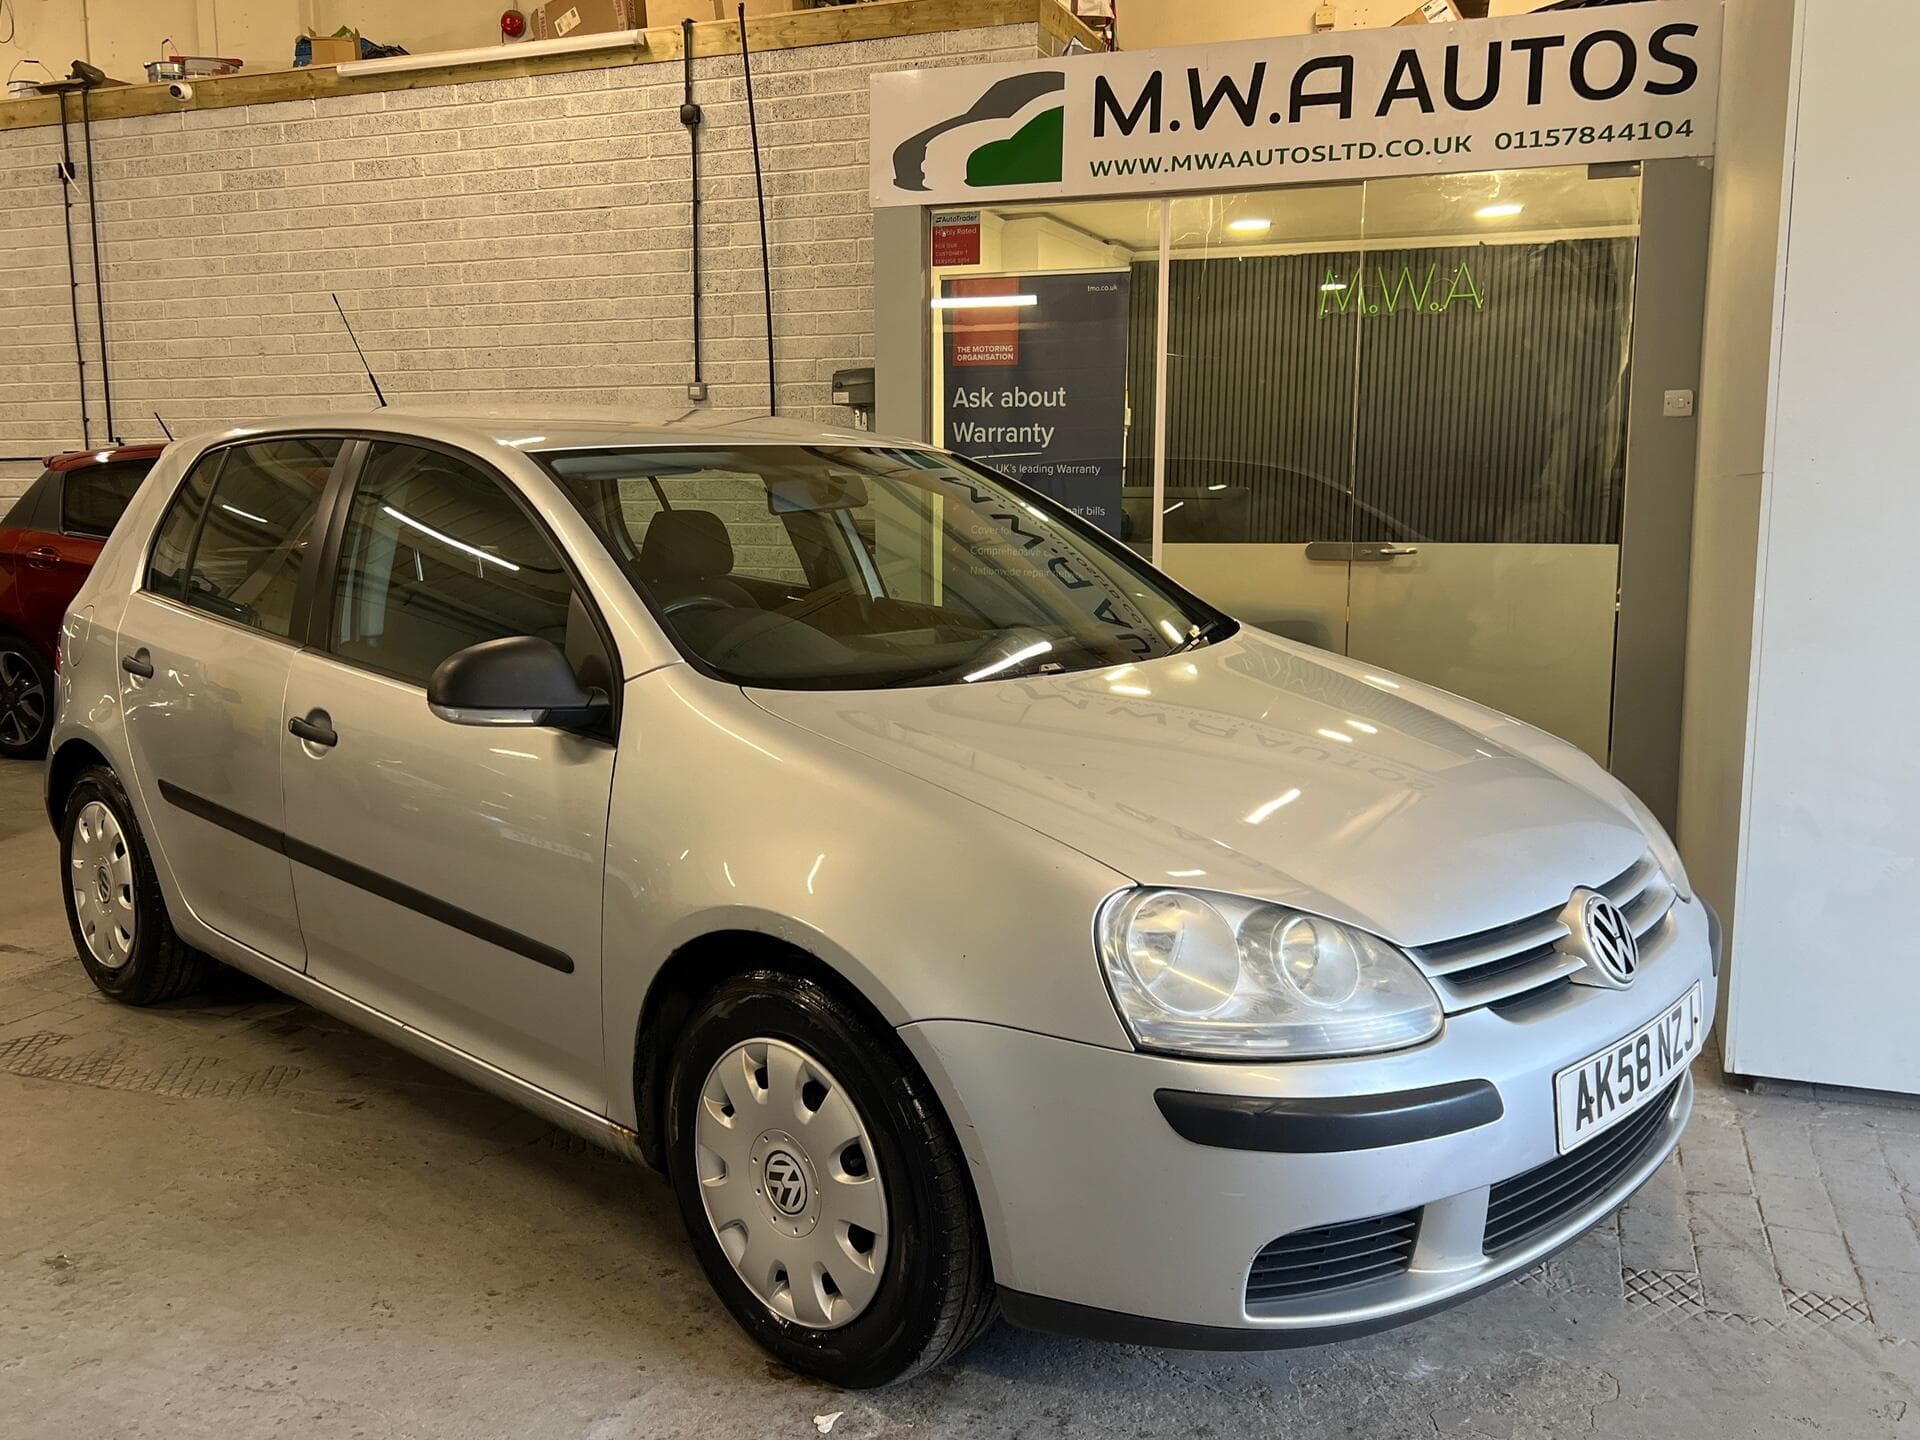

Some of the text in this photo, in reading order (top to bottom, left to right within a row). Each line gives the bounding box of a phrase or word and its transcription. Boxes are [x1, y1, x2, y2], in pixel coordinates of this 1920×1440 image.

[1093, 22, 1699, 138] M.W.A AUTOS
[1089, 118, 1694, 178] WWW.MWAAUTOSLTD.CO.UK 01157844104
[942, 214, 977, 223] AutoTrader
[1087, 283, 1118, 293] tmo.co.uk
[1320, 262, 1482, 317] M.W.A
[957, 344, 1014, 354] THE MOTORING
[957, 352, 1014, 362] ORGANISATION
[952, 385, 1067, 408] Ask about
[952, 420, 1055, 448] Warranty
[995, 463, 1017, 474] UK's
[1019, 463, 1054, 476] leading
[1056, 463, 1101, 476] Warranty
[1086, 506, 1106, 516] bills
[1576, 994, 1694, 1132] AK58 NZJ
